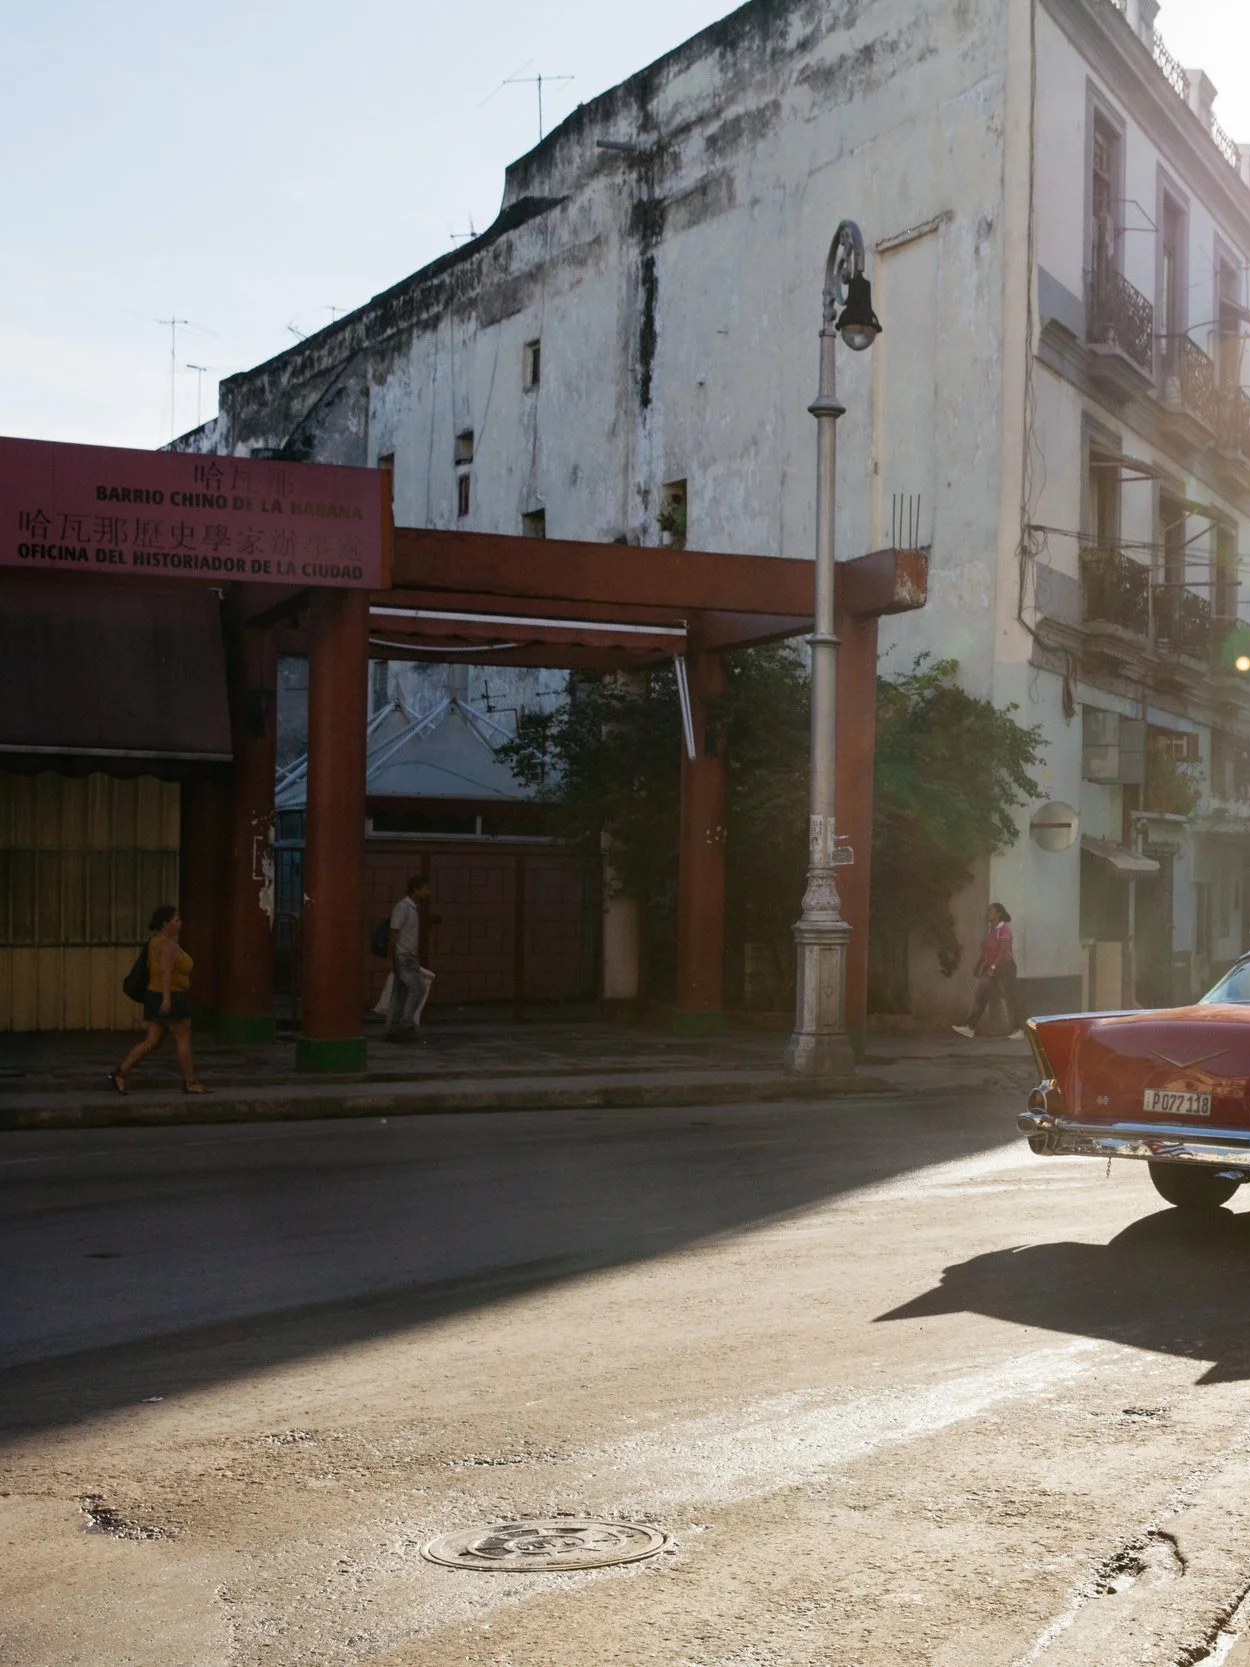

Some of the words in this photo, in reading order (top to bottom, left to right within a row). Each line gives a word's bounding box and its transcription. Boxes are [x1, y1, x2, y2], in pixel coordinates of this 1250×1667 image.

[95, 485, 164, 505] BARRIO
[170, 491, 228, 510] CHINO
[233, 495, 254, 512] DE
[261, 499, 283, 515] LA
[291, 502, 363, 521] HABANA
[17, 543, 89, 562] OFICINA
[95, 548, 126, 565] DEL
[133, 550, 246, 574] HISTORIADOR
[251, 559, 272, 575] DE
[277, 560, 297, 576] LA
[302, 563, 363, 580] CIUDAD
